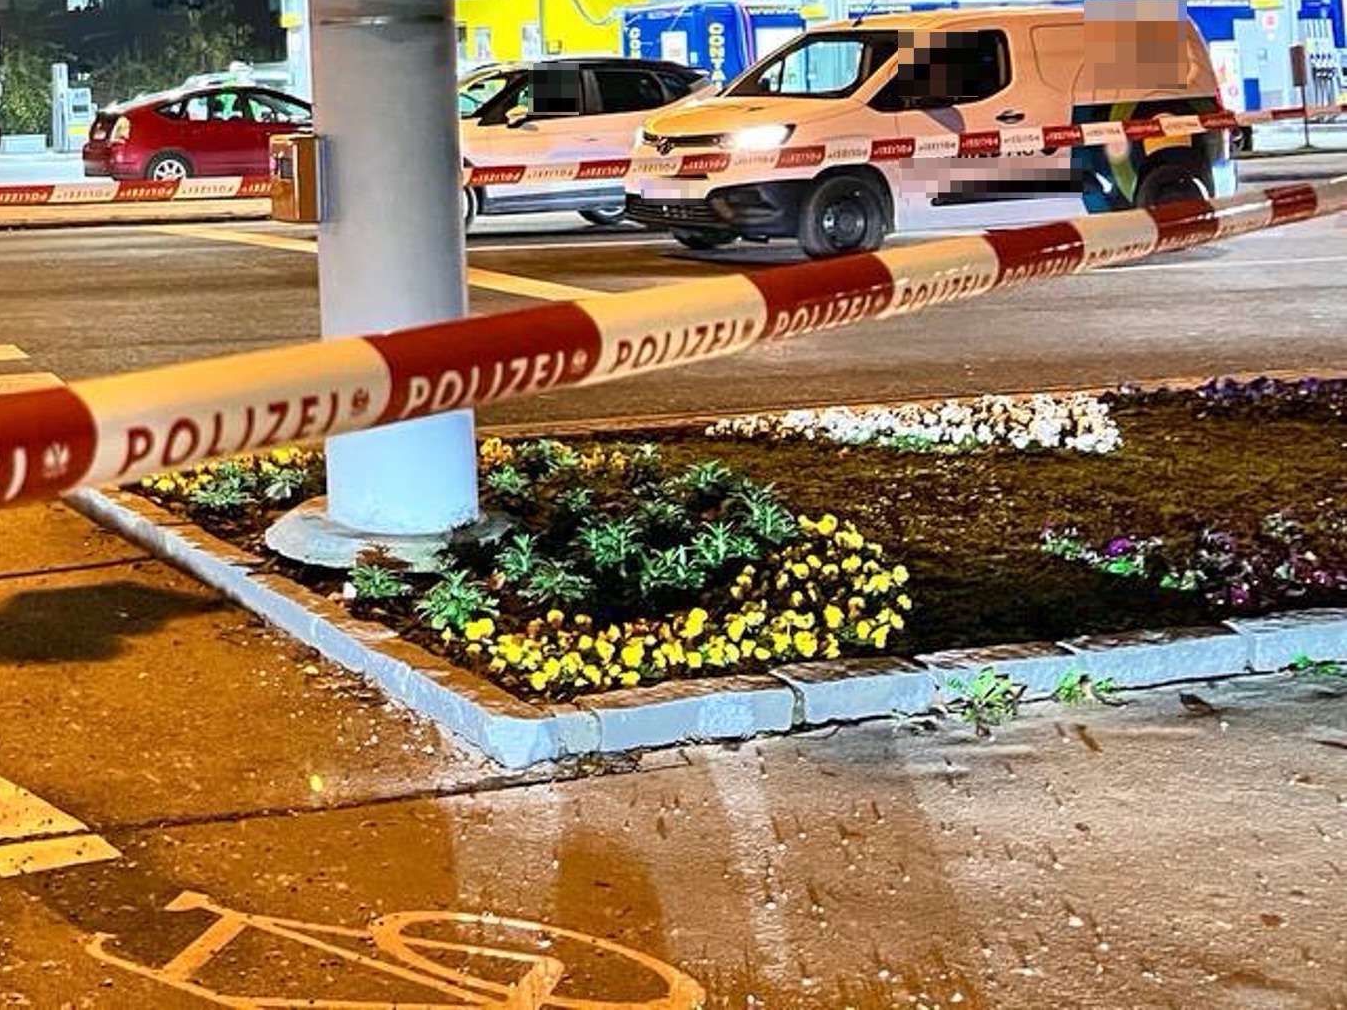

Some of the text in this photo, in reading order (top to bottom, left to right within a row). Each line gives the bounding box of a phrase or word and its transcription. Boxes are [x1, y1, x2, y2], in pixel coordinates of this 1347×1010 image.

[117, 390, 341, 476] POLIZEI
[400, 350, 565, 418] POLIZEI
[607, 318, 738, 374] POLIZEI
[769, 294, 872, 339] POLIZEI
